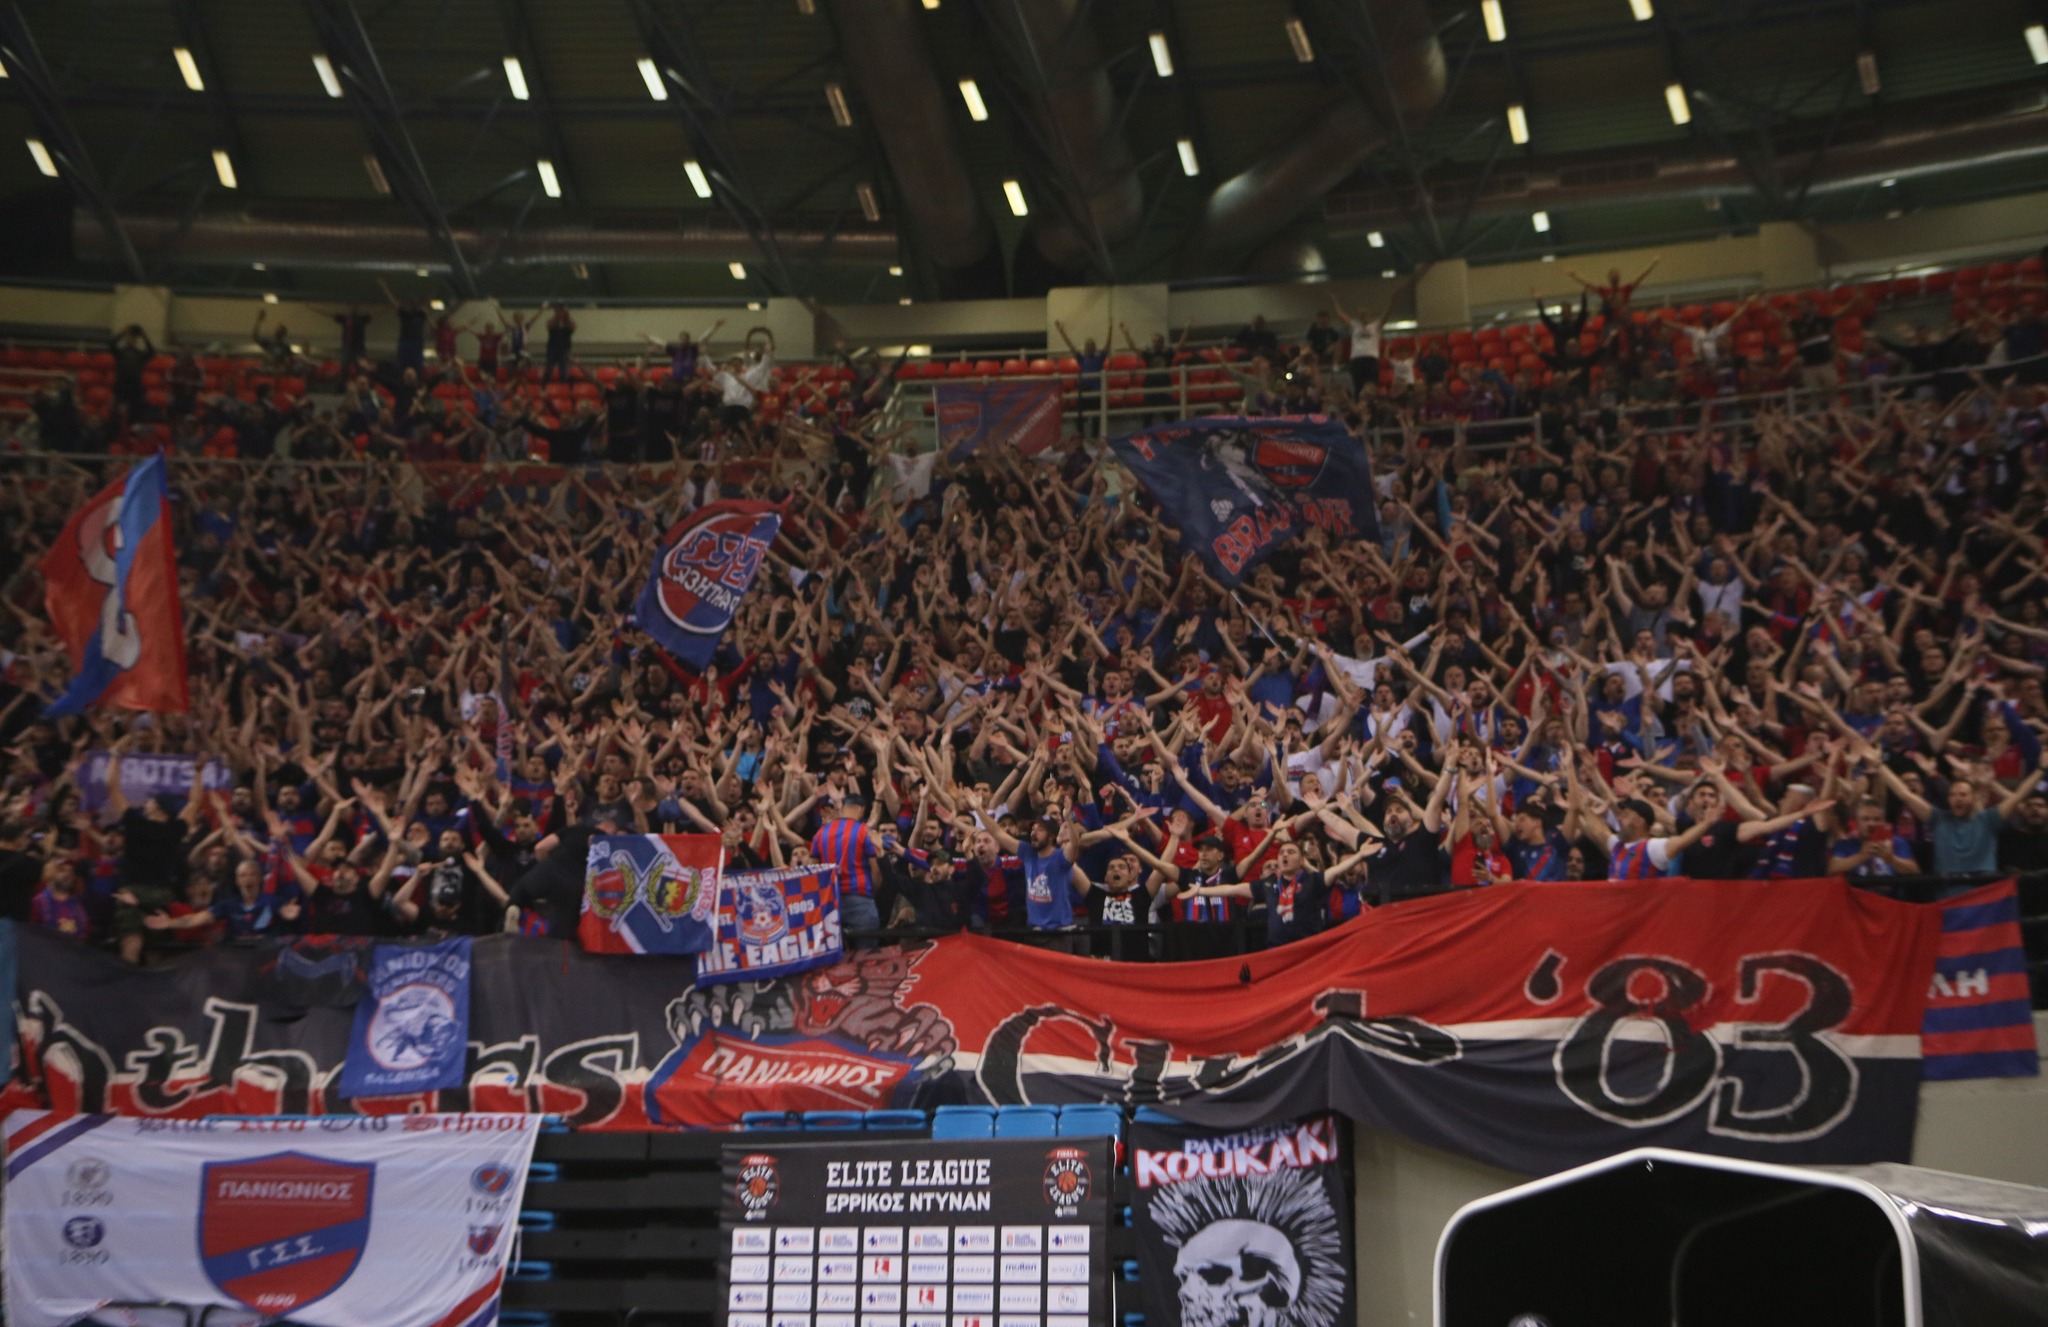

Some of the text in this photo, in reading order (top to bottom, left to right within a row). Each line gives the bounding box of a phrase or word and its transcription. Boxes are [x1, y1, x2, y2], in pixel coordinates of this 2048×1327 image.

[788, 898, 815, 915] 1905
[745, 908, 841, 967] EAGLES
[702, 1046, 896, 1098] ΠΑΝΙΩΝΙΟΣ
[1135, 1115, 1339, 1190] KOUKAKI
[742, 1164, 774, 1182] ELITE
[826, 1159, 991, 1188] ELITE LEAGUE
[1051, 1158, 1084, 1177] ELITE
[217, 1180, 354, 1200] ΠΑΝΙΩΝΙΟΣ
[1049, 1184, 1085, 1206] LEAGUE
[825, 1191, 991, 1214] ΕΡΡΙΚΟΣ ΝΤΥΝΑΝ
[255, 1292, 298, 1308] 1890
